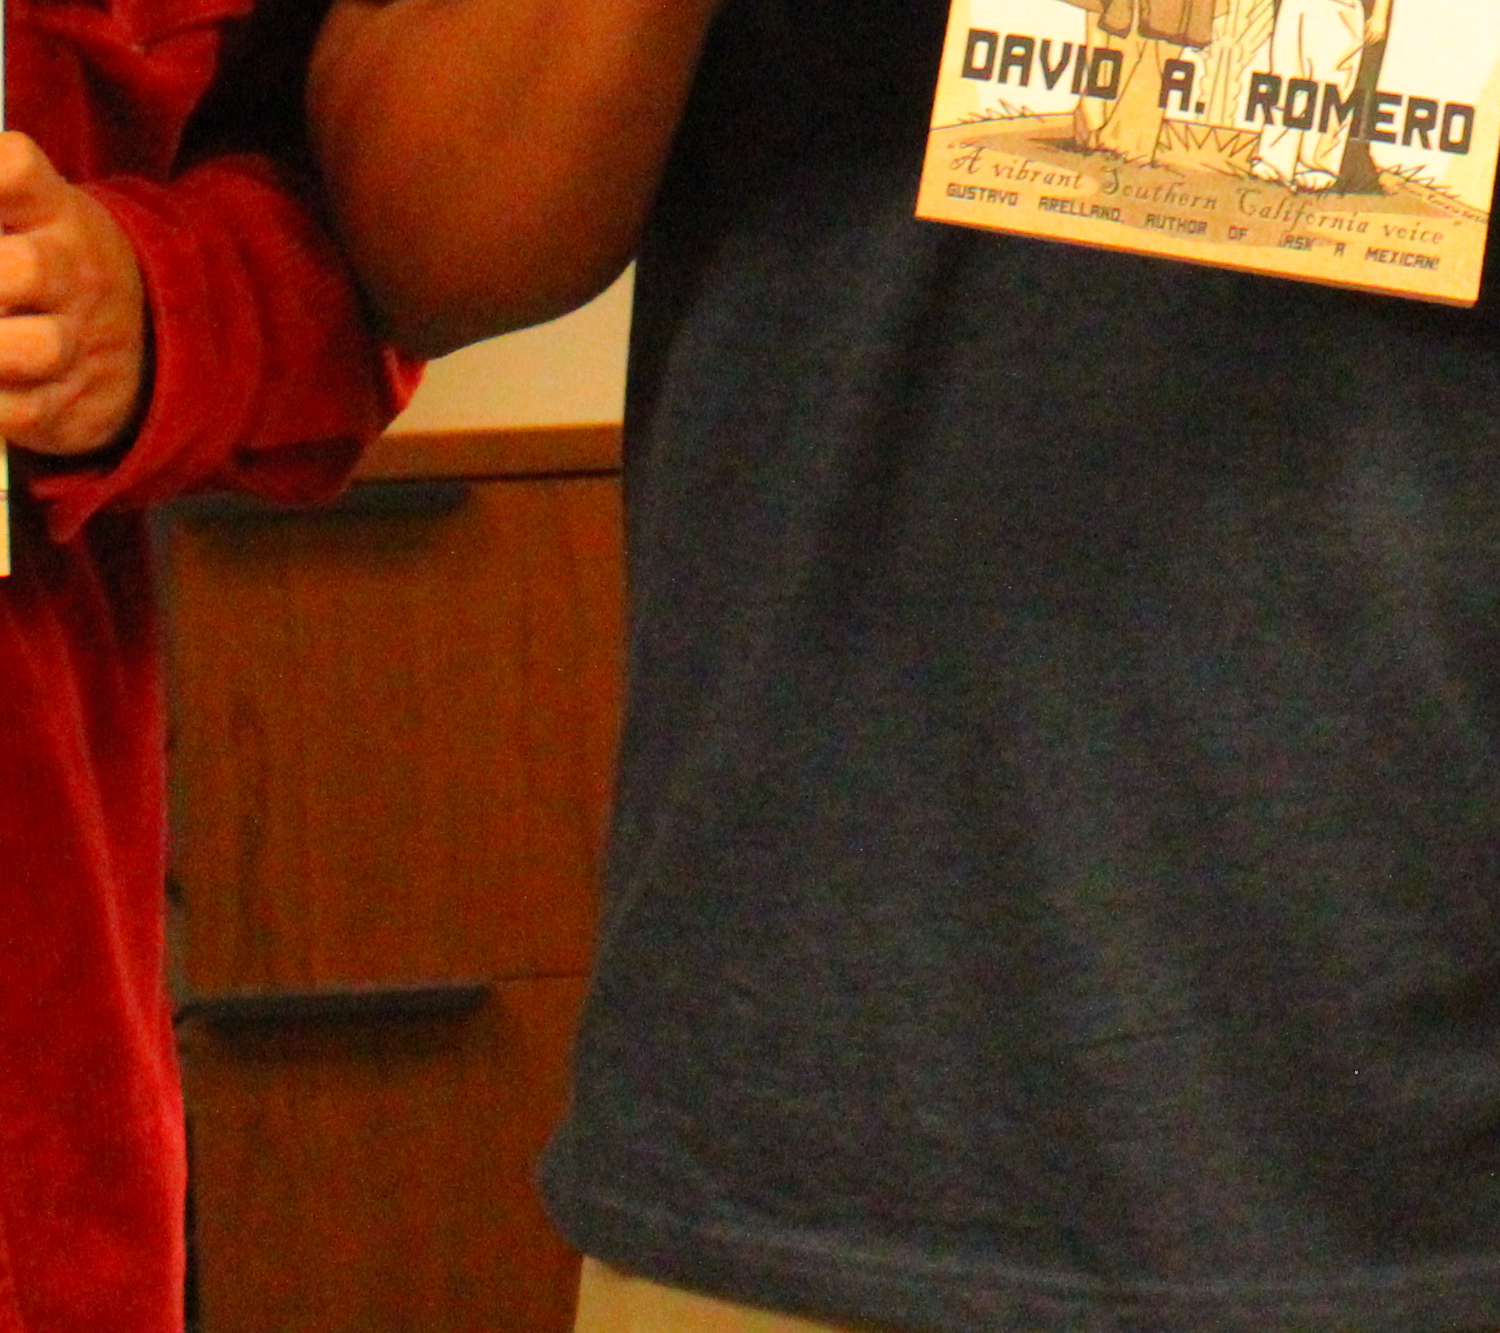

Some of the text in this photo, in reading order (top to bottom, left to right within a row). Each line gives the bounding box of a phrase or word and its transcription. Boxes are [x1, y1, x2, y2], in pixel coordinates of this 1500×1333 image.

[961, 29, 1477, 155] DAVID A. ROMERO
[946, 183, 1018, 207] GUSTAVO
[1144, 213, 1208, 235] AUTHOR
[1228, 225, 1248, 241] OF
[1334, 243, 1346, 257] A
[993, 160, 1084, 190] vibrant
[1100, 166, 1218, 211] Southern
[1237, 188, 1370, 234] California
